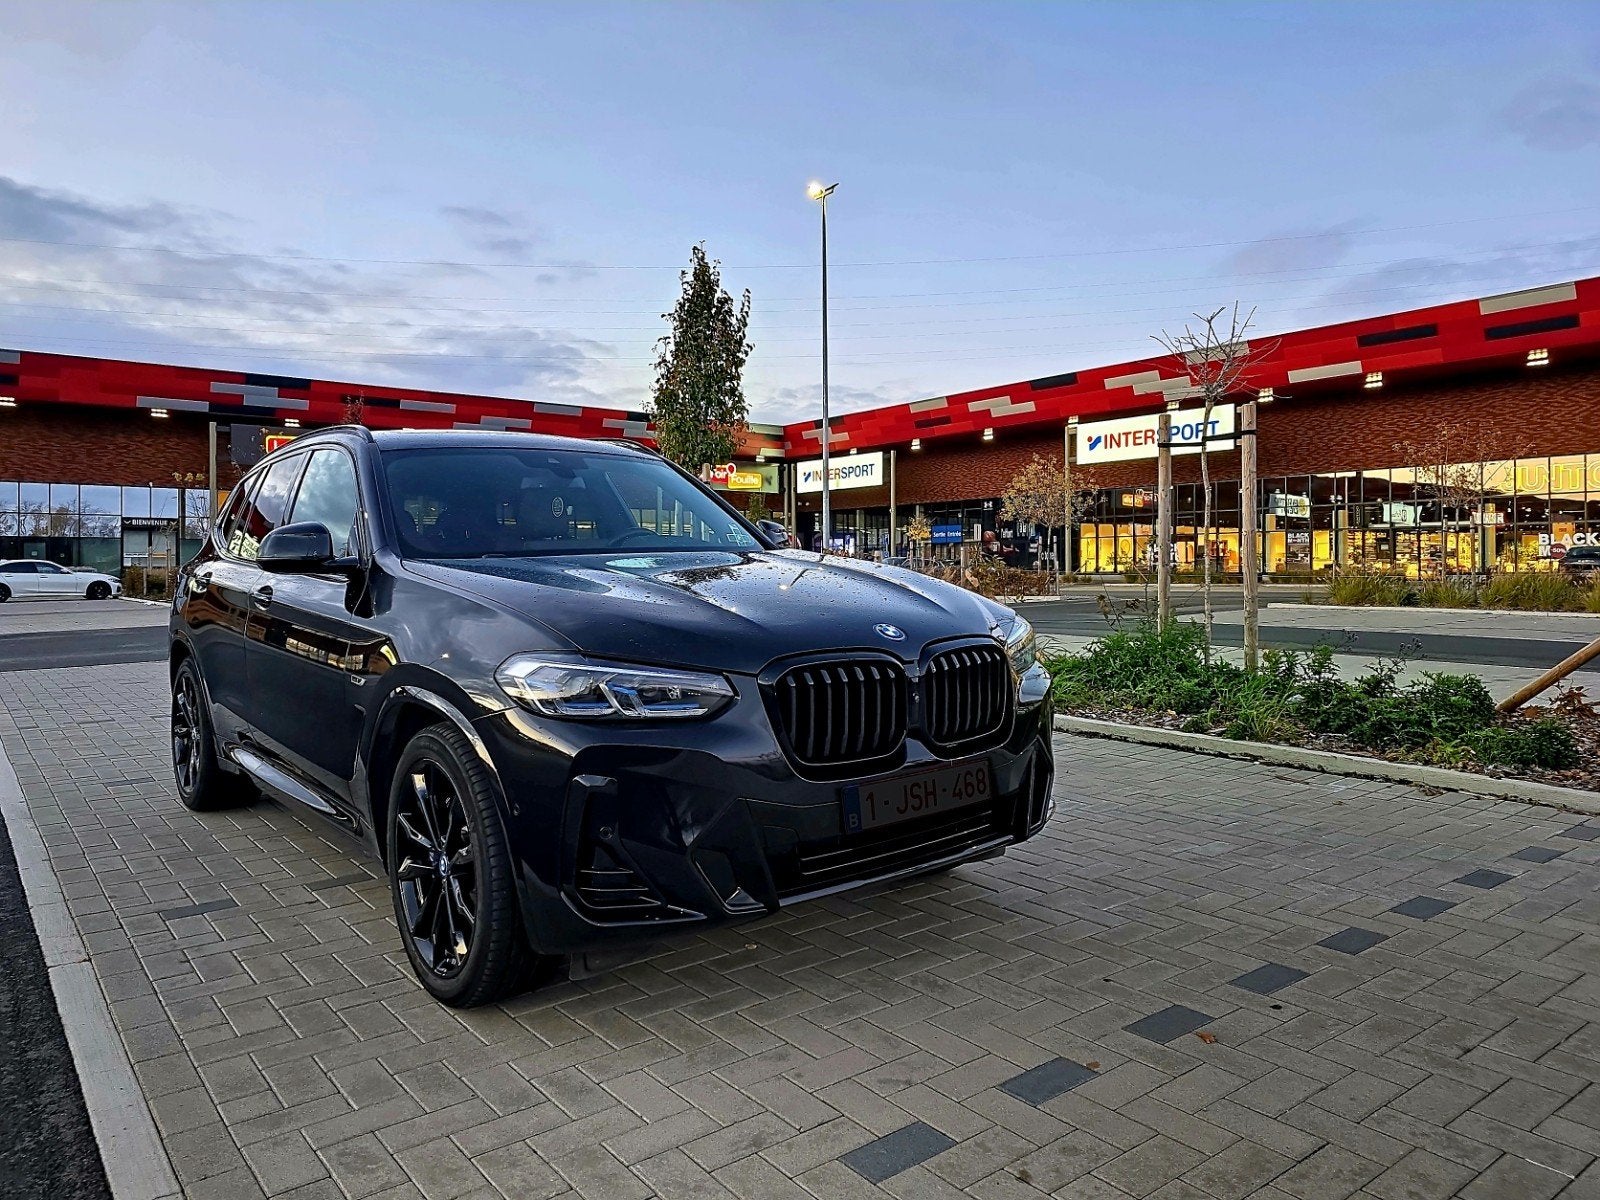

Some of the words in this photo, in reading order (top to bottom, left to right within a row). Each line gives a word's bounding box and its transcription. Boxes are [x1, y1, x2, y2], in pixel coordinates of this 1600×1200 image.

[1104, 420, 1220, 450] INTERPORT
[730, 474, 759, 485] Fouille
[812, 463, 875, 482] INERSPORT
[1538, 532, 1599, 546] BLACK
[849, 813, 859, 828] B
